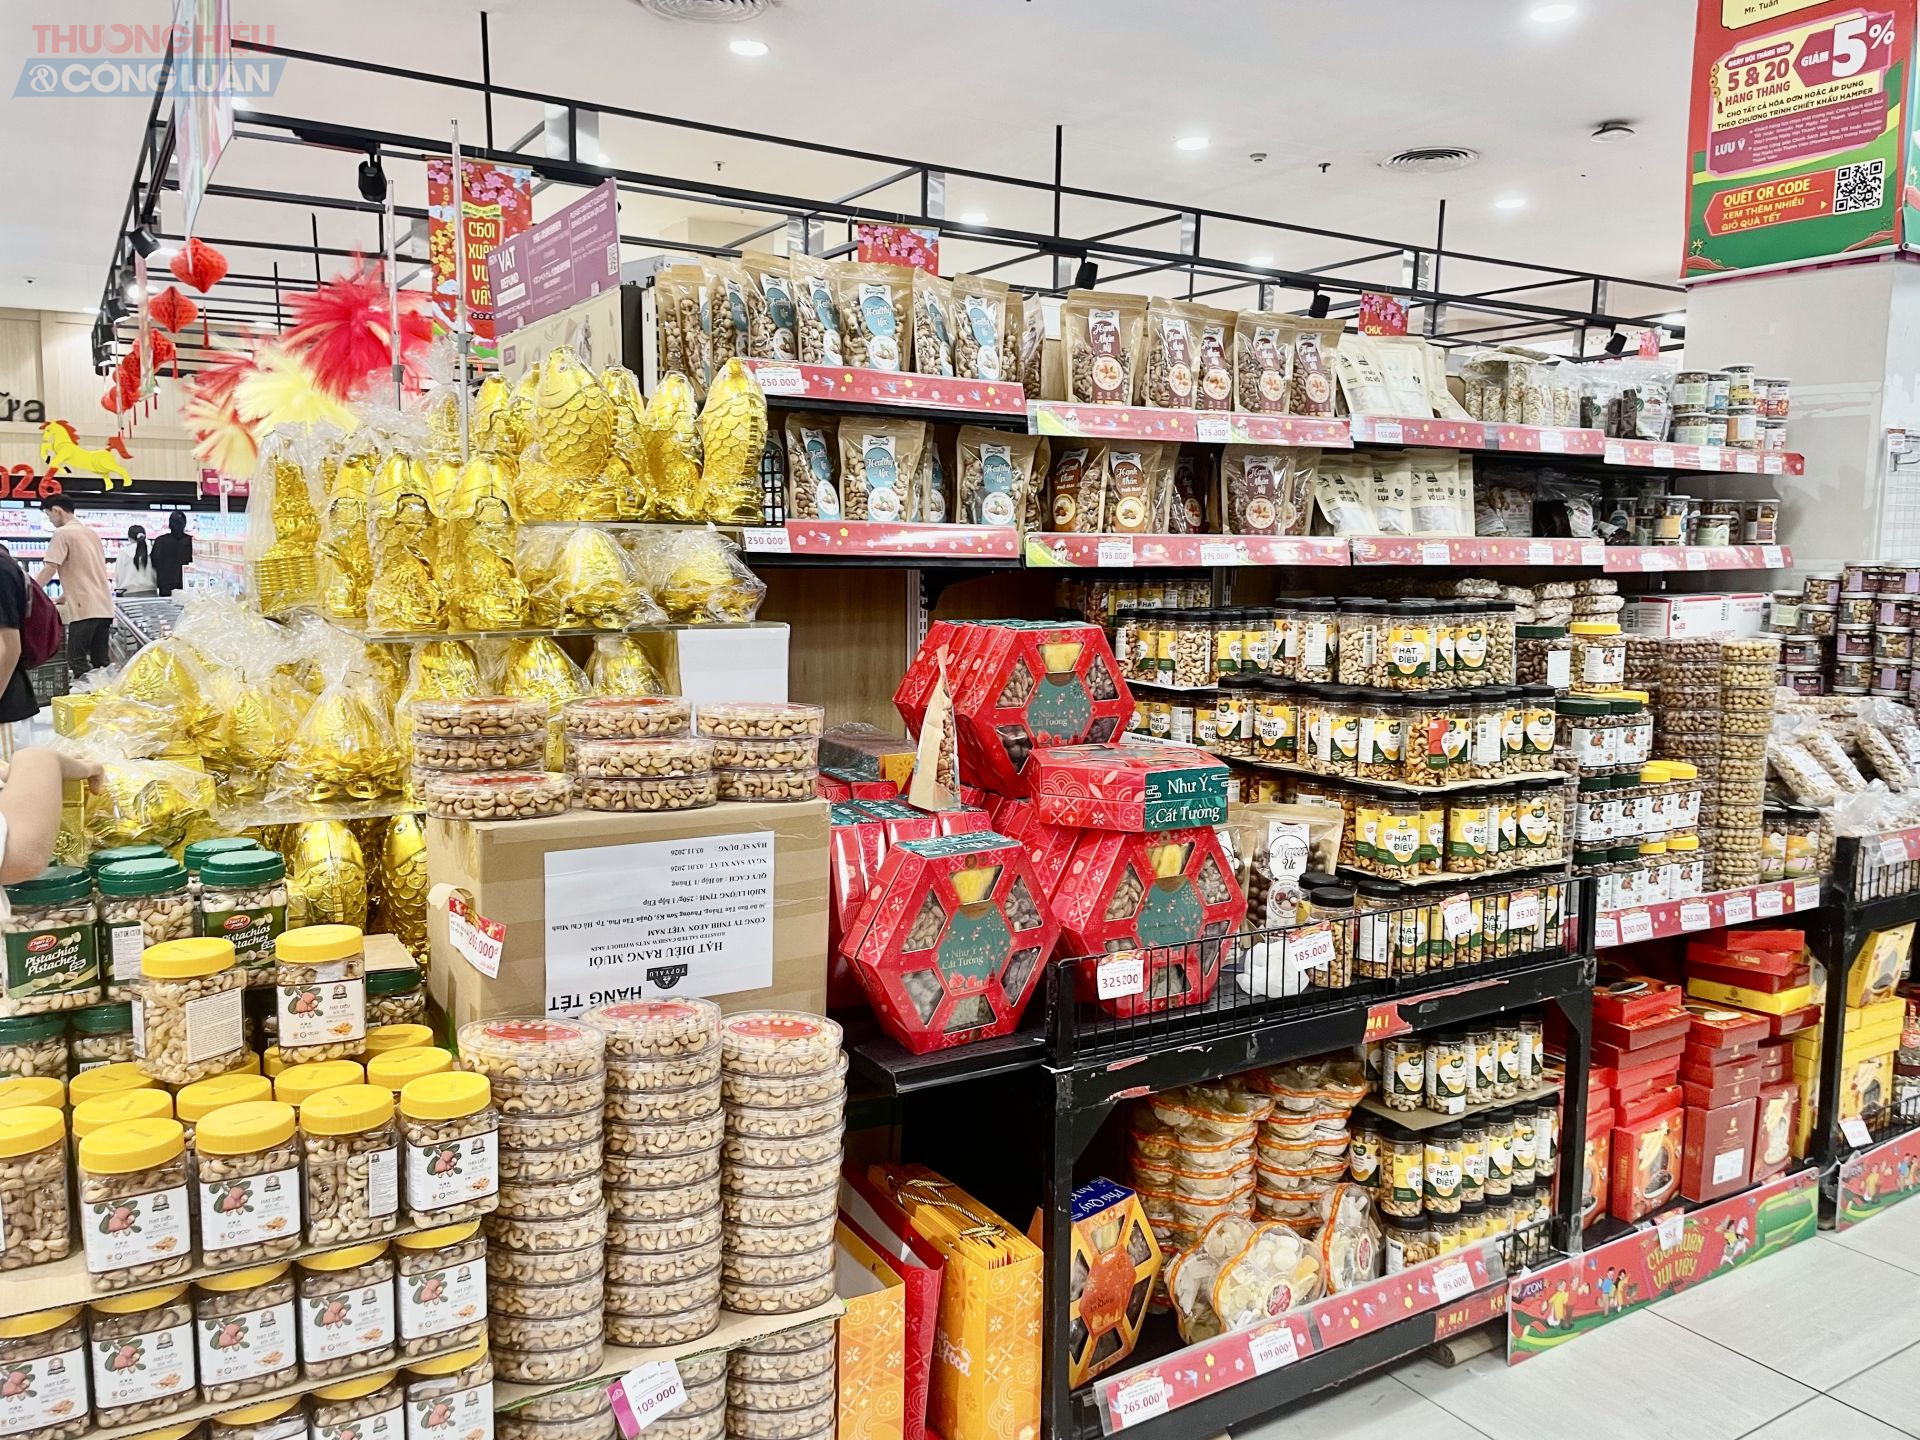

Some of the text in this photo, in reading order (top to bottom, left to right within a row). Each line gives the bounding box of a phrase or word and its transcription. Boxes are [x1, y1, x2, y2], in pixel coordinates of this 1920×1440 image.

[1744, 5, 1757, 15] Mr.
[1801, 50, 1829, 67] GIẢM
[1728, 57, 1790, 91] 5 & 20
[1717, 121, 1737, 130] THEO
[1840, 87, 1874, 101] HAMPER
[1726, 109, 1742, 118] CHO
[1756, 184, 1775, 200] QR
[1777, 178, 1811, 195] CODE
[1722, 209, 1745, 221] XEM
[1747, 203, 1774, 217] THÊM
[497, 245, 516, 273] VAT
[1167, 772, 1209, 795] Như Ý
[1155, 803, 1220, 824] Cát Tường
[670, 848, 704, 856] 03.11.2026
[670, 864, 704, 872] 03.01.2026
[647, 928, 666, 936] NAM
[689, 922, 710, 932] AEON
[652, 937, 677, 945] CASHEW
[699, 932, 726, 940] ROASTED
[606, 941, 634, 950] WITHOUT
[25, 944, 80, 968] Pistachios
[627, 949, 662, 962] RANG
[27, 954, 78, 977] Pistaches
[649, 967, 685, 977] TOPVALU
[548, 993, 584, 1013] TẾT
[636, 1381, 681, 1415] 109.000đ
[1123, 1390, 1164, 1415] 265.000đ
